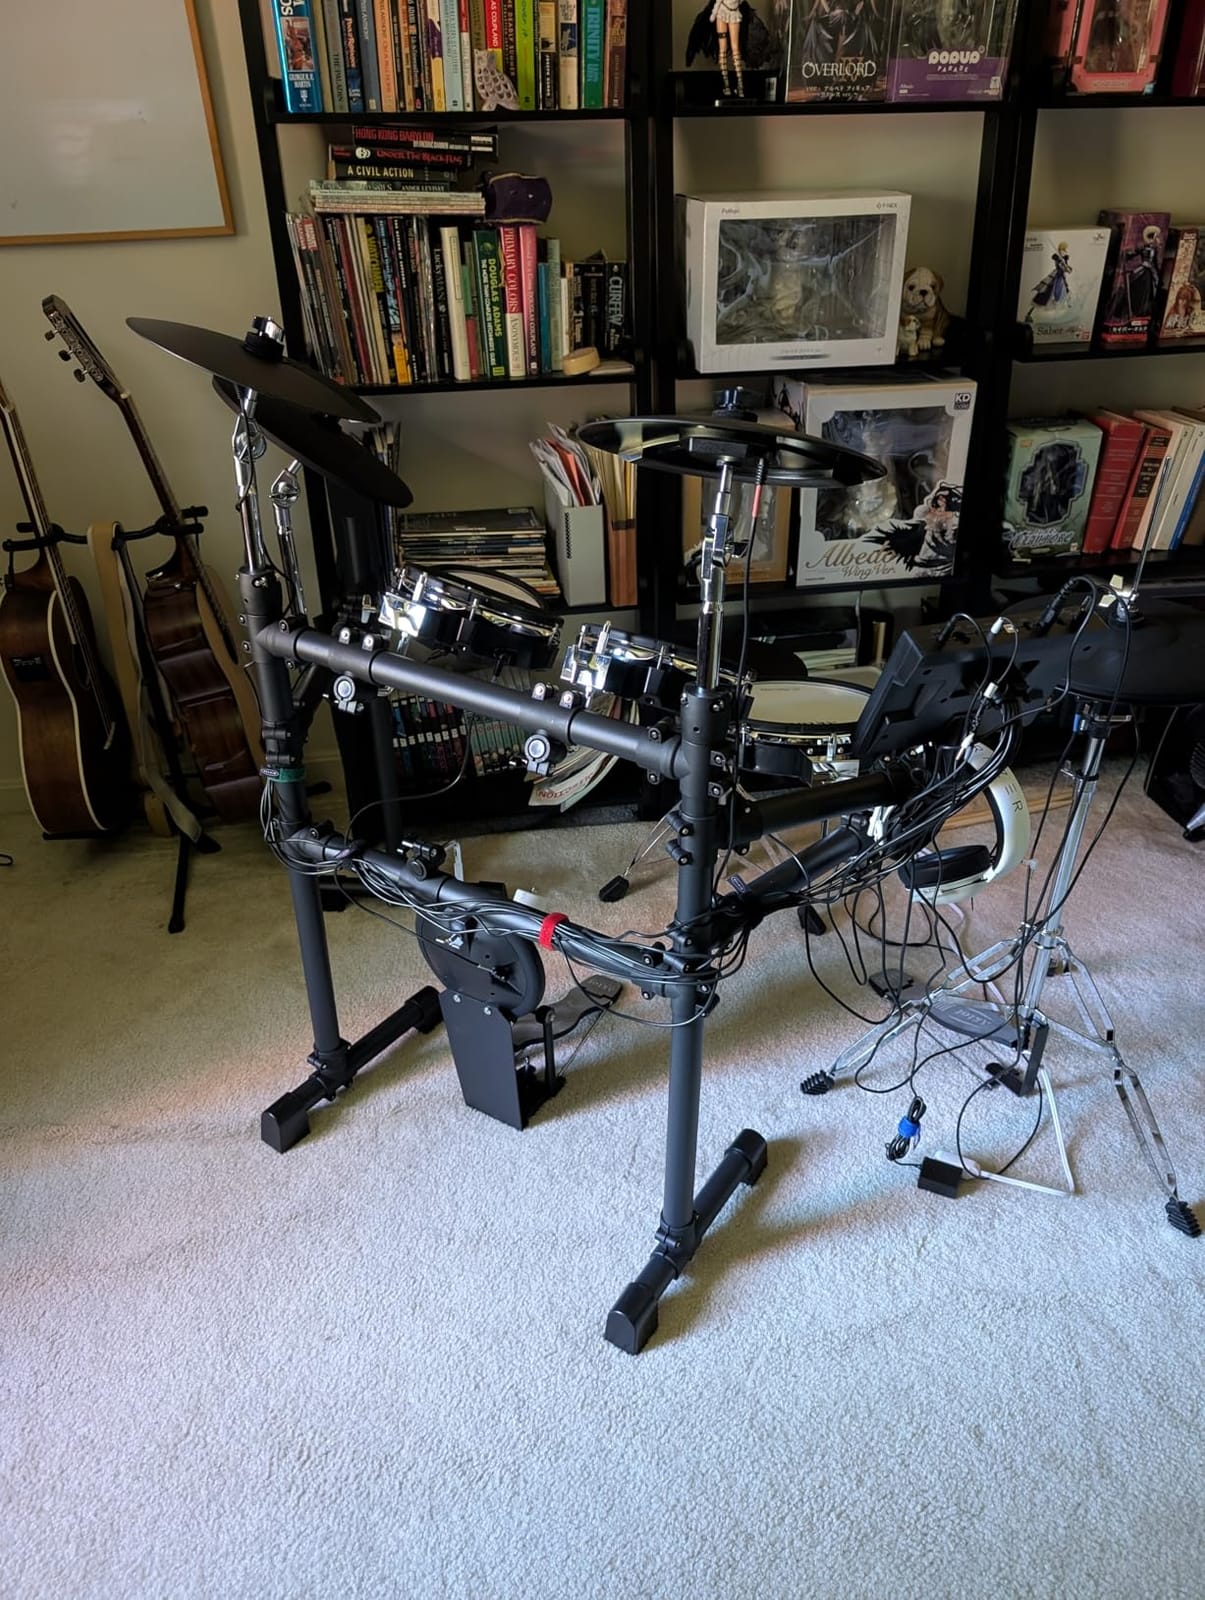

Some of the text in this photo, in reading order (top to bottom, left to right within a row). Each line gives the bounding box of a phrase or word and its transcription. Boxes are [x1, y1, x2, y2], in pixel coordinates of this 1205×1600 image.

[586, 7, 601, 61] TRINITY
[801, 60, 877, 79] OVERLORD
[355, 127, 377, 140] HONG
[378, 128, 398, 141] KONG
[376, 149, 404, 158] UNDER
[422, 151, 446, 162] BLACK
[347, 165, 414, 178] A CIVIL ACTION
[367, 237, 385, 293] WATCHMEN
[503, 228, 520, 312] PRIMARY COLORS
[484, 298, 492, 321] COMPLETE
[488, 258, 502, 337] DOUGLAS ADAMS
[527, 291, 536, 321] DOUGLAS
[608, 276, 624, 326] CURFEW
[510, 318, 522, 362] ANONYMOUS
[528, 322, 537, 356] COUPLAND
[955, 393, 971, 402] KD
[805, 543, 896, 569] Albedo
[841, 565, 895, 580] Wing Ver.
